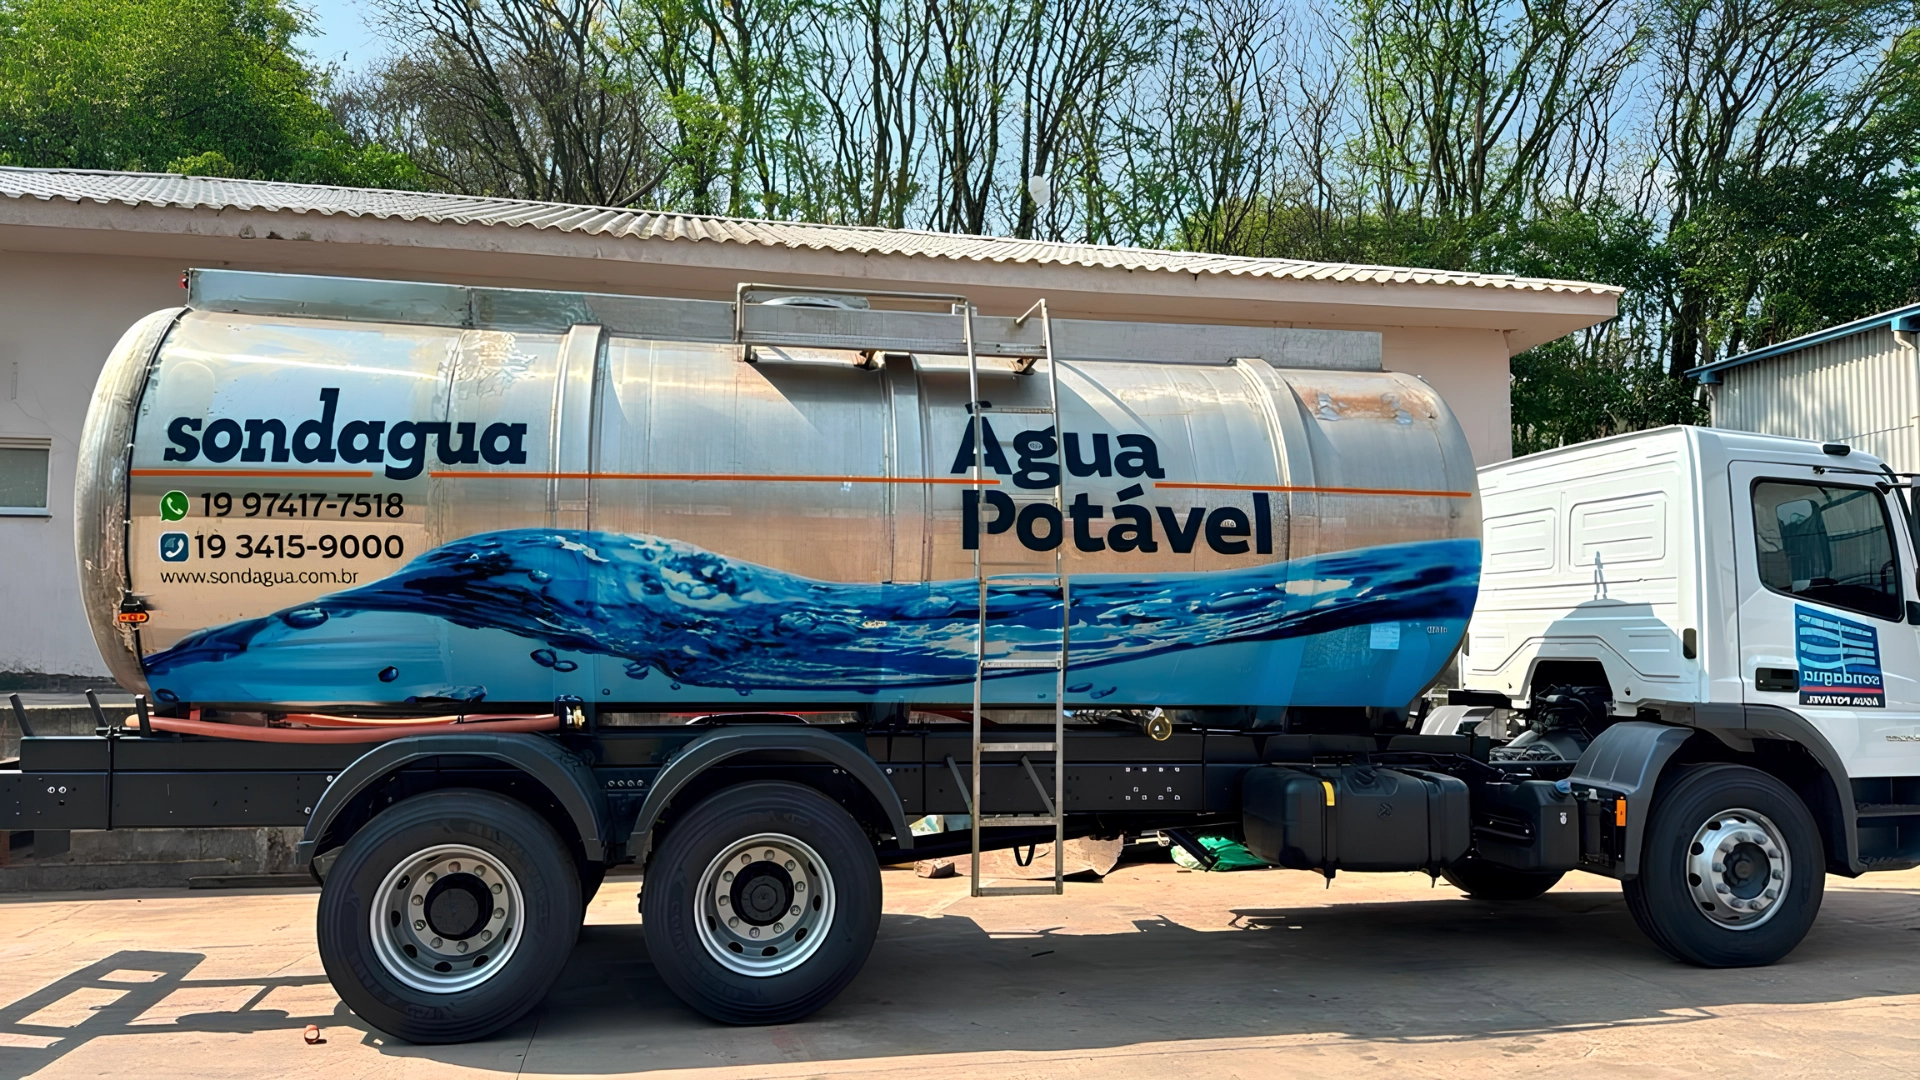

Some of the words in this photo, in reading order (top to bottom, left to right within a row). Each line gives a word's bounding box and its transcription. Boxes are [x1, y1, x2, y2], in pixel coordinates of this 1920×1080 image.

[164, 388, 527, 480] sondagua
[950, 400, 1165, 489] Água
[200, 492, 232, 517] 19
[242, 492, 404, 518] 97417-7518
[962, 483, 1273, 555] Potável
[194, 534, 226, 559] 19
[235, 534, 404, 559] 3415-9000
[160, 568, 359, 587] www.sondagua.com.br
